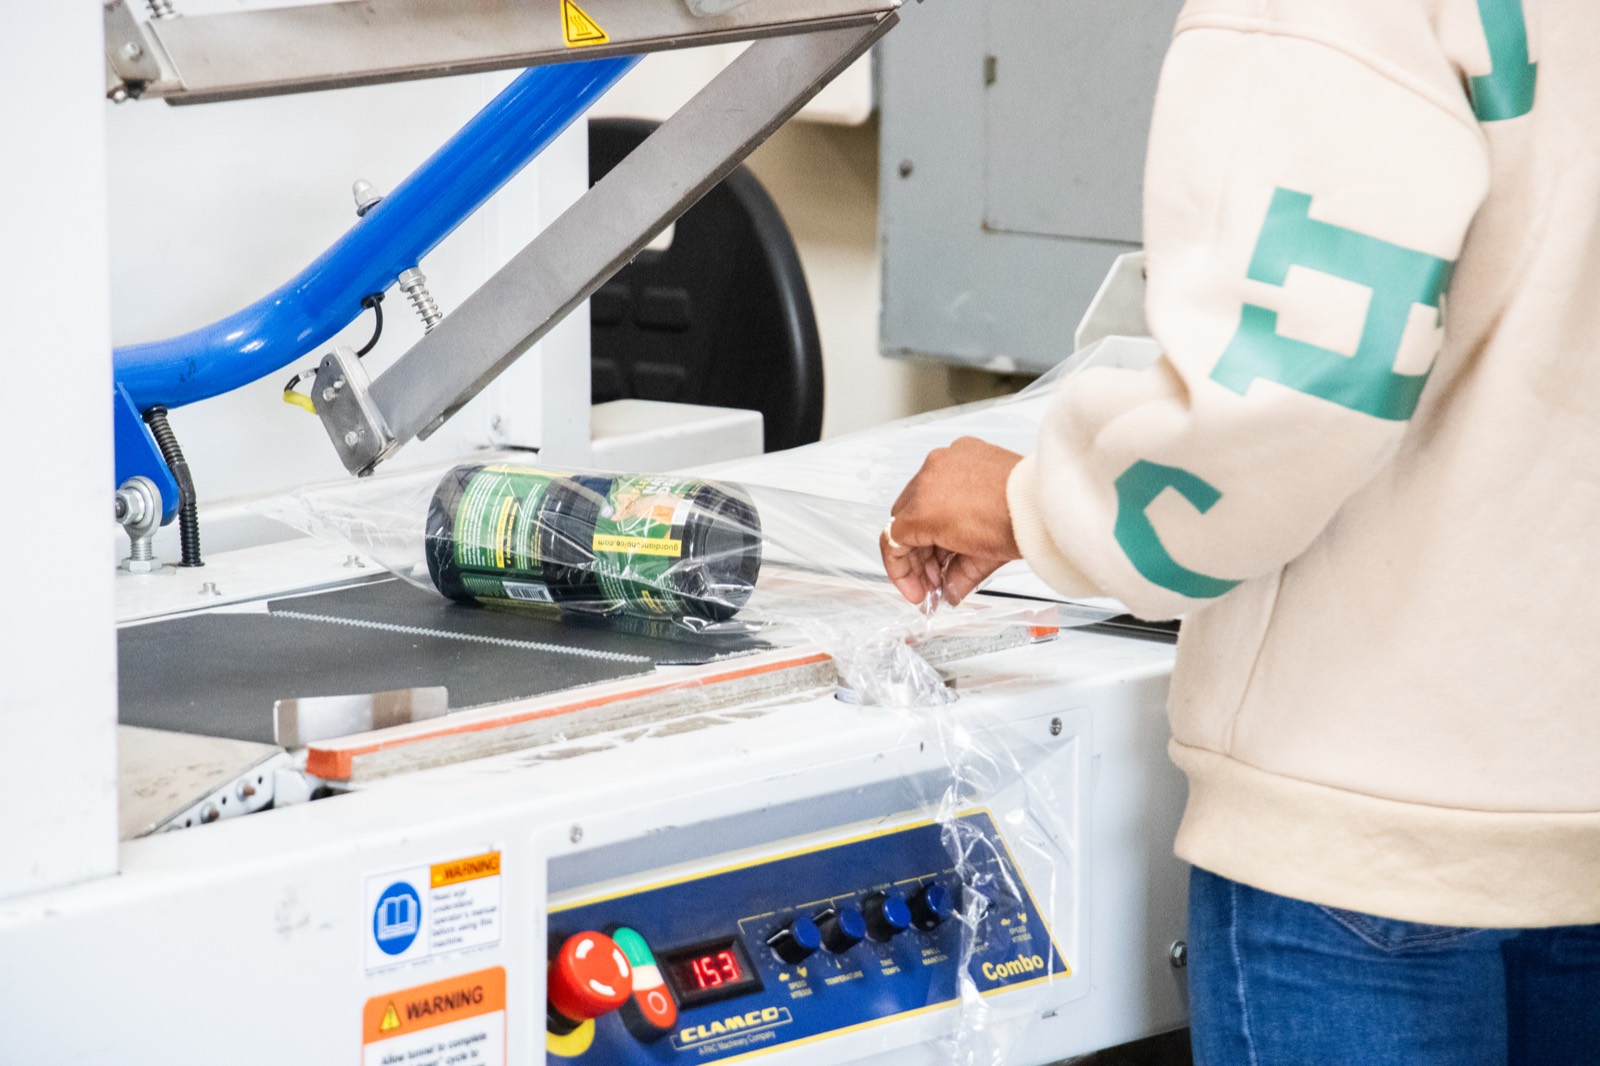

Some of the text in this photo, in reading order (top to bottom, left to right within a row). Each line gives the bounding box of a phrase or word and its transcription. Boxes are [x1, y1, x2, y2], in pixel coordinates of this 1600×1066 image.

[444, 855, 499, 878] WARNING
[692, 950, 741, 989] 153
[981, 953, 1045, 981] Combo
[406, 985, 483, 1020] WARNING
[680, 1006, 779, 1043] CLAMCO
[437, 1042, 446, 1052] to
[448, 1032, 487, 1050] complete
